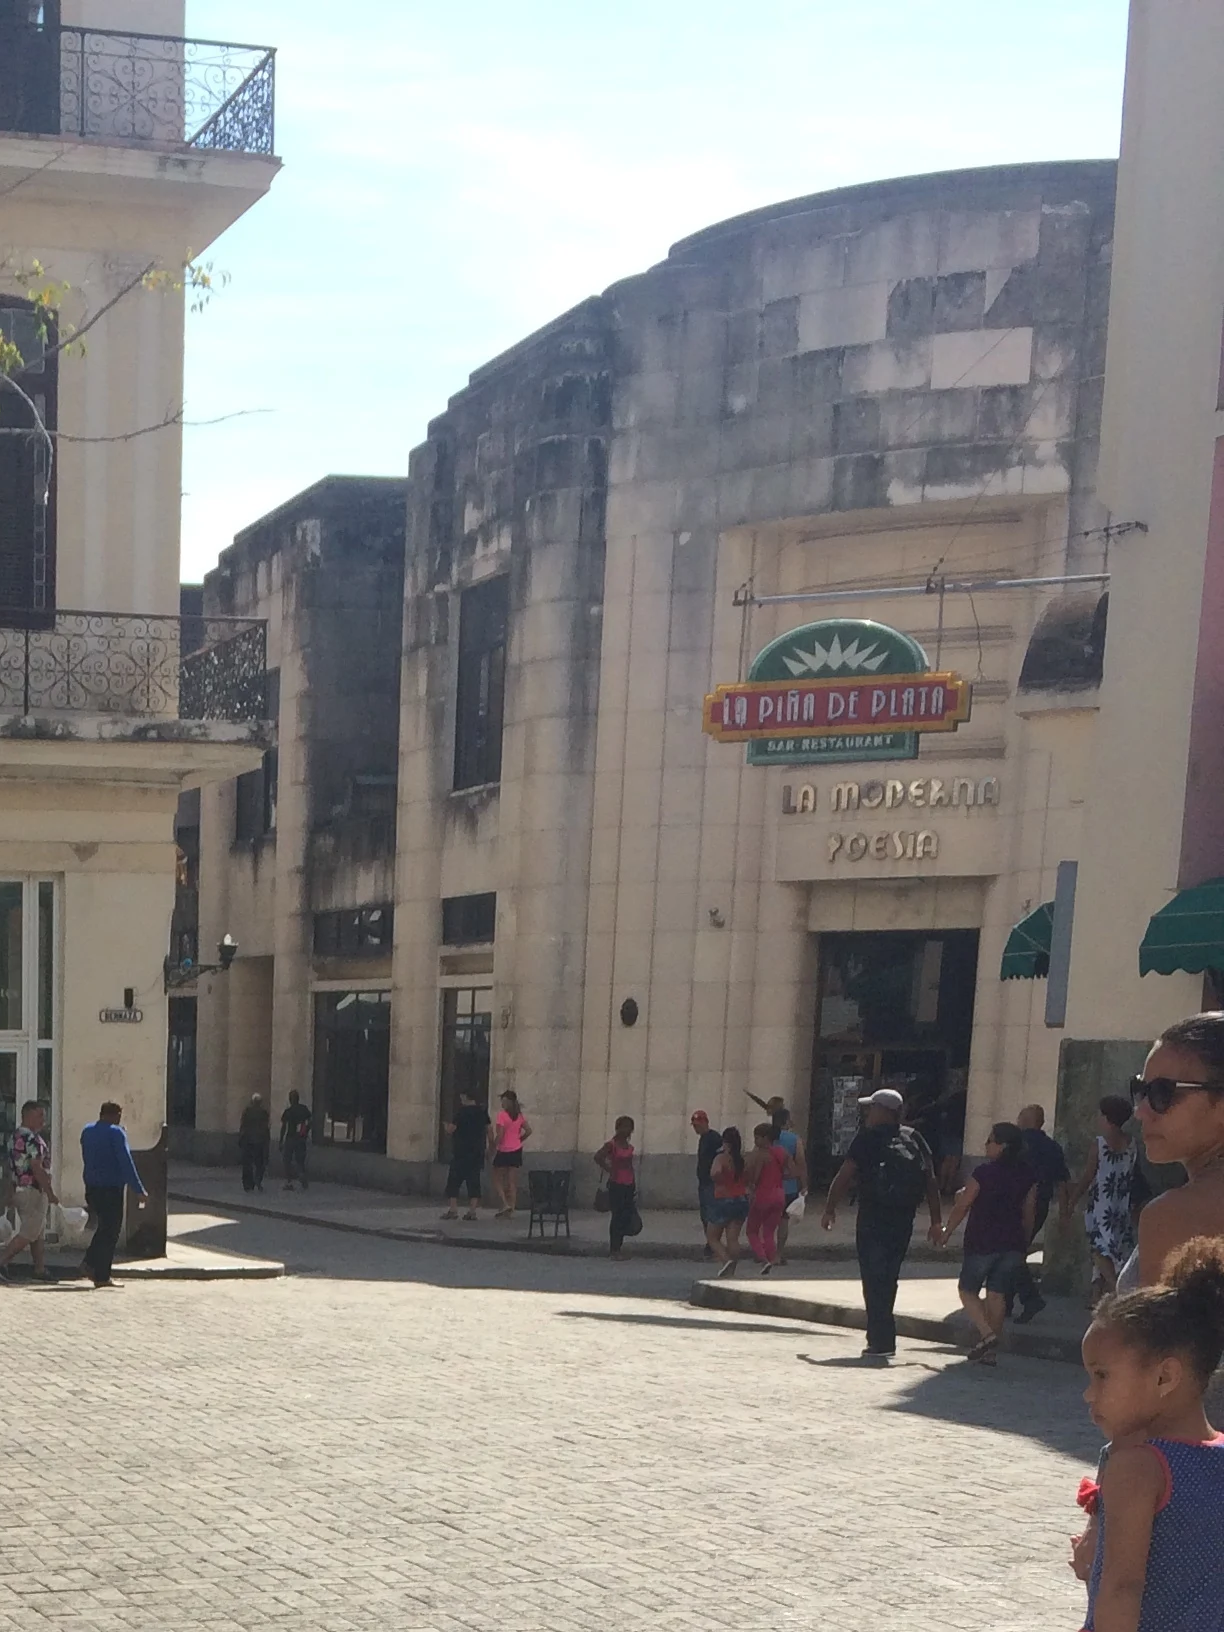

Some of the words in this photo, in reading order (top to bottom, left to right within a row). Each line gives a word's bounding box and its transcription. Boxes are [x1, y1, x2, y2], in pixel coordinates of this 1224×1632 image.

[723, 694, 748, 727] LA
[758, 689, 815, 723] PIÑA
[827, 691, 859, 719] DE
[871, 686, 944, 718] PLATA
[782, 783, 817, 814] LA
[831, 776, 1001, 812] MODERNA
[828, 829, 940, 862] POESIA
